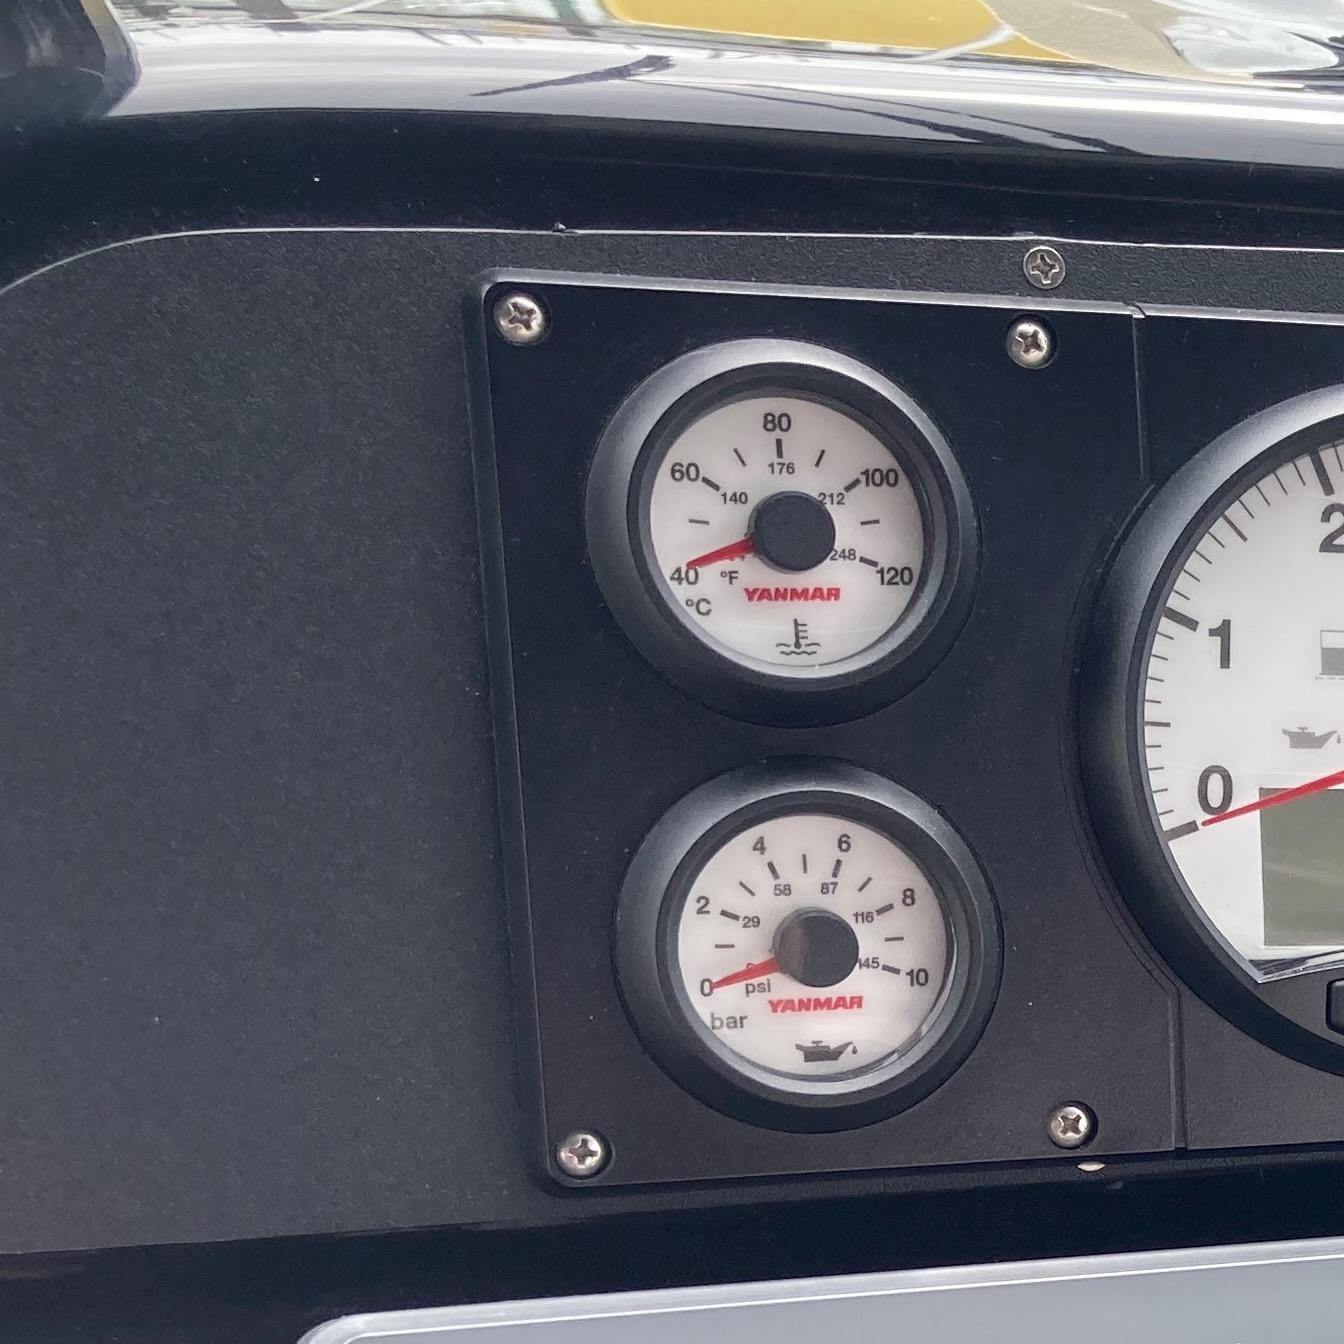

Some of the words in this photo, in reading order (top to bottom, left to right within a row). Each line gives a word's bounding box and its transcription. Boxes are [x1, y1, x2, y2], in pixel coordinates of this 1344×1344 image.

[763, 413, 791, 432] 80
[671, 463, 700, 482] 60
[768, 462, 795, 475] 176
[861, 468, 898, 488] 100
[722, 492, 749, 505] 140
[818, 493, 845, 506] 212
[830, 549, 856, 561] 248
[670, 566, 699, 586] 40
[876, 567, 913, 586] 120
[744, 587, 840, 602] YANMAR
[1208, 619, 1232, 669] 1
[1197, 765, 1233, 815] 0
[752, 836, 767, 855] 4
[838, 834, 851, 852] 6
[773, 883, 792, 896] 58
[820, 882, 838, 895] 87
[902, 888, 916, 906] 8
[696, 896, 710, 914] 2
[742, 916, 761, 928] 29
[853, 911, 874, 923] 116
[700, 978, 713, 997] 0
[905, 970, 929, 987] 10
[745, 979, 771, 998] psi
[768, 996, 863, 1013] YANMAR
[711, 1013, 748, 1030] bar
